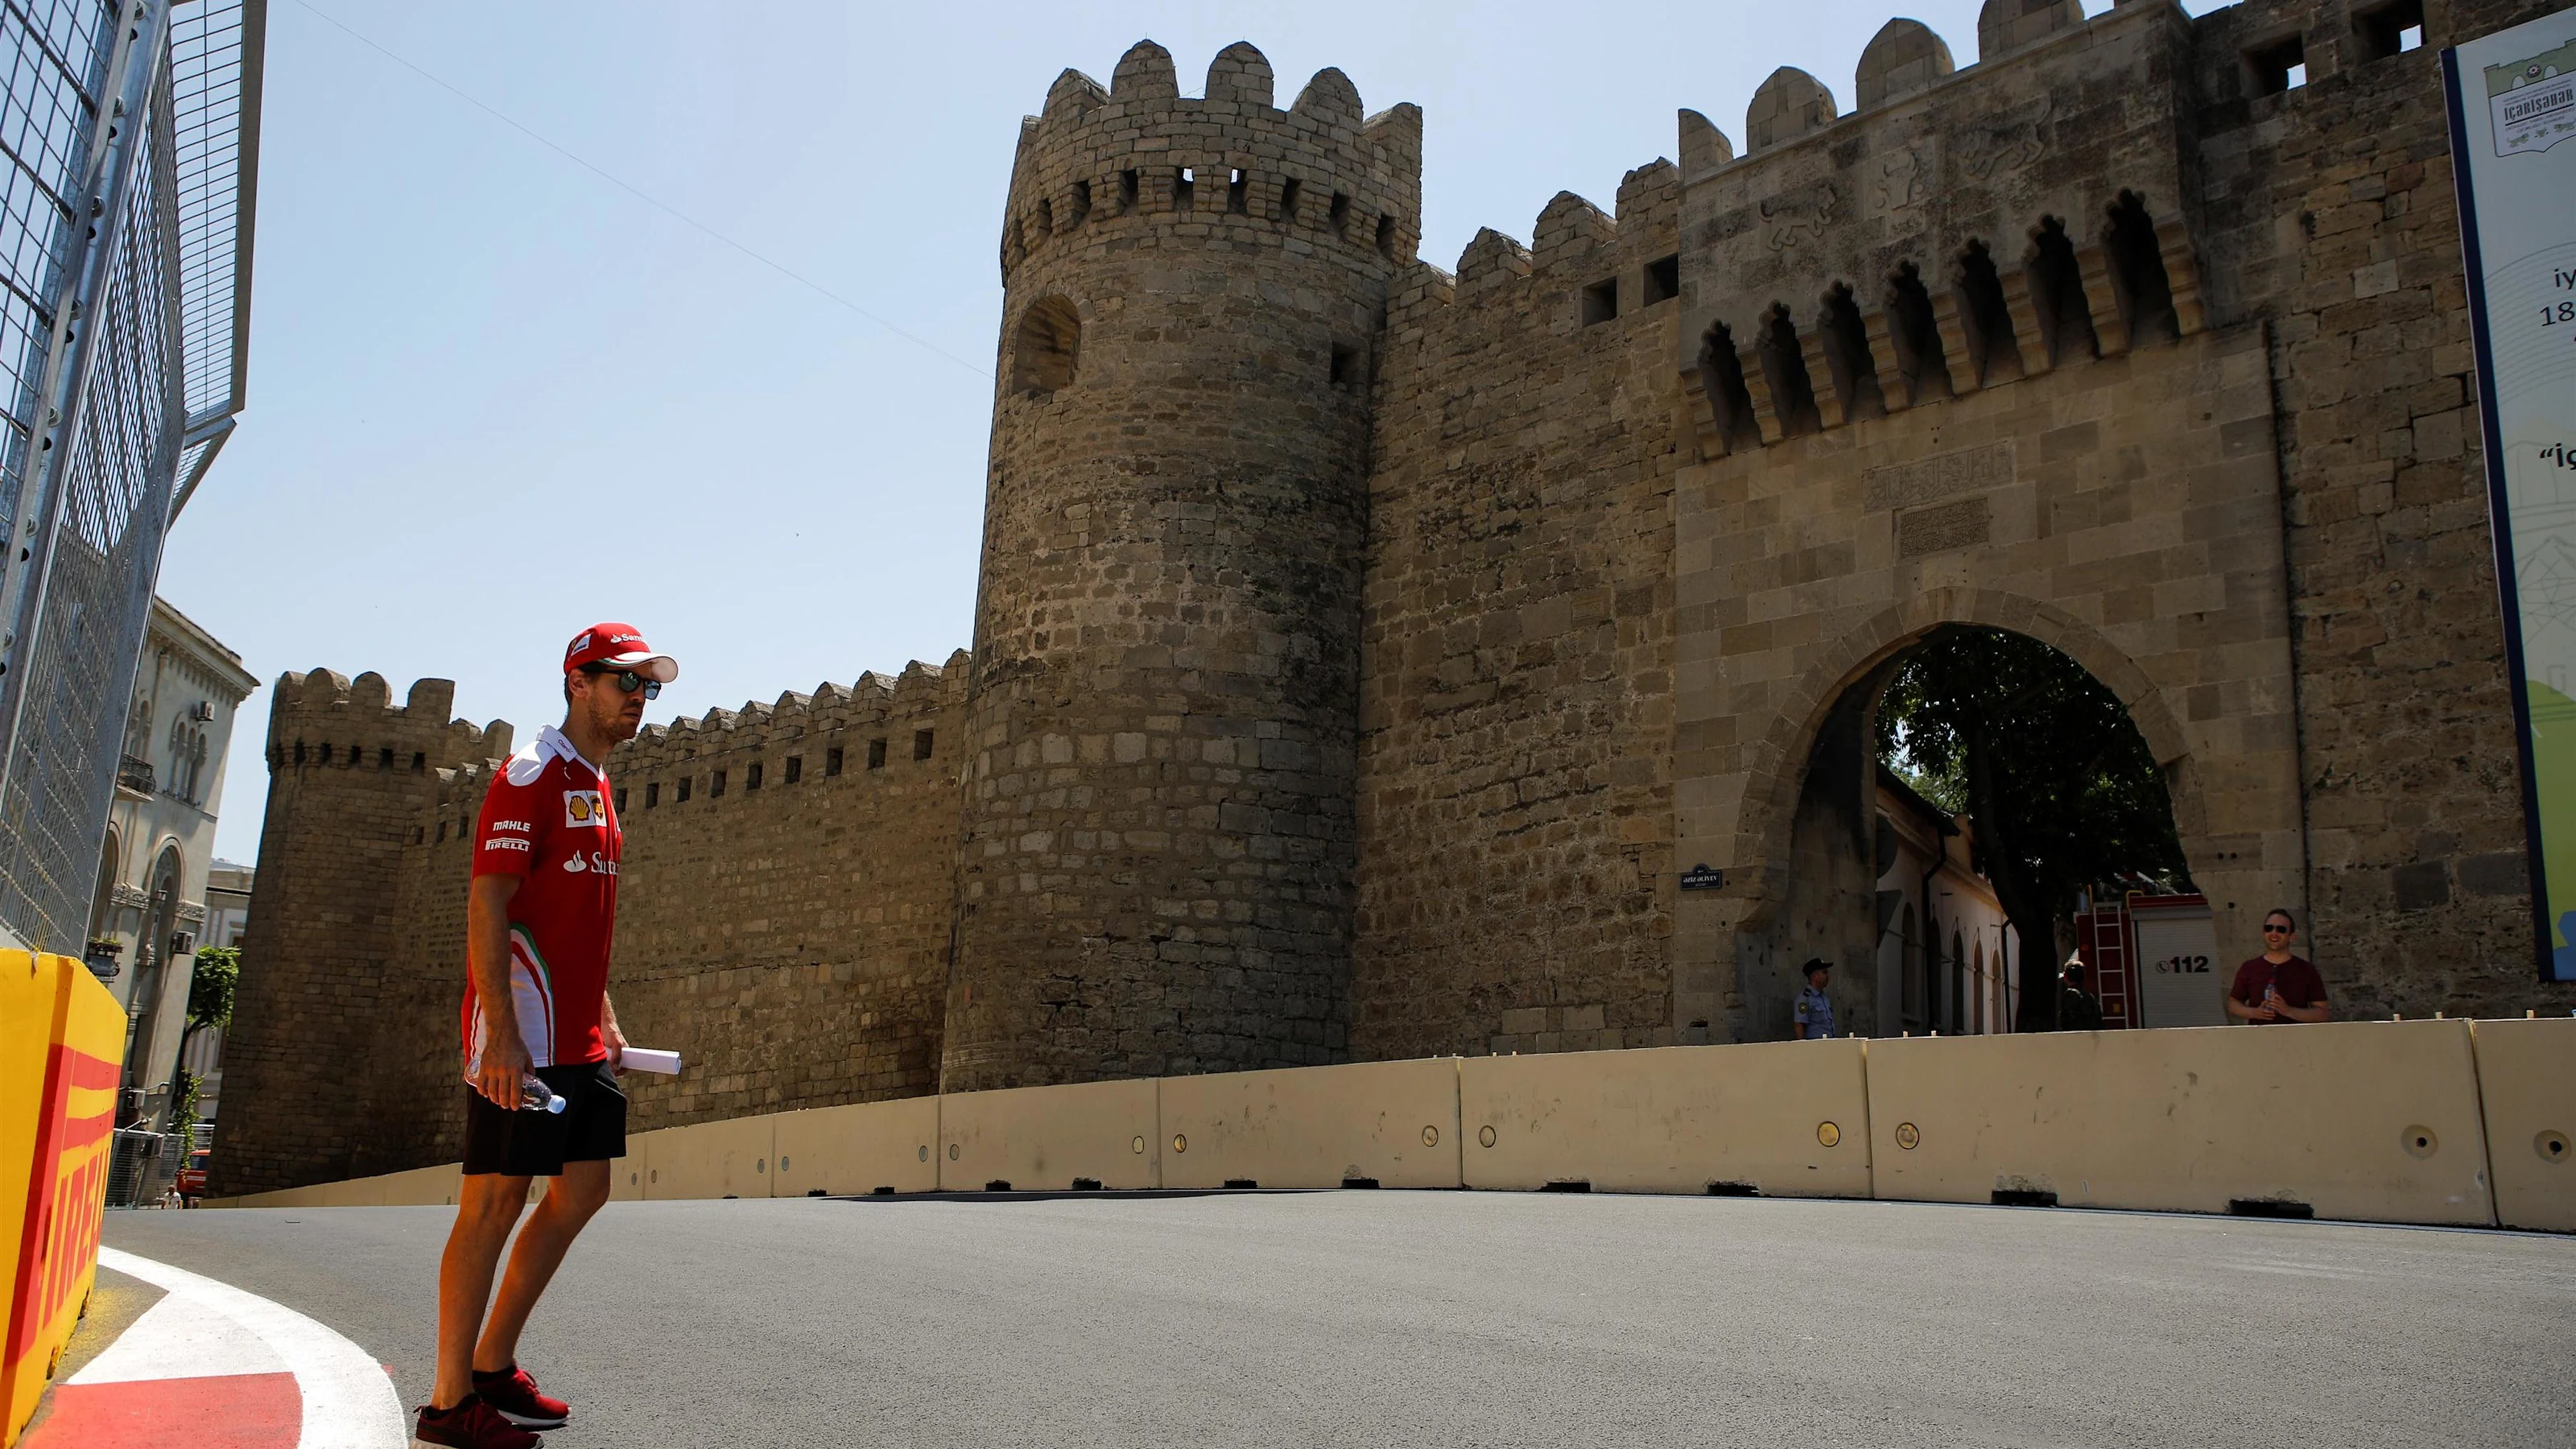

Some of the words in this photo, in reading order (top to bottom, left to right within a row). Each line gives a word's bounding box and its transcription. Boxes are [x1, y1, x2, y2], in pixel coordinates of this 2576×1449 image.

[493, 819, 531, 832] MAHLE
[485, 837, 530, 852] PIRELLI
[2170, 956, 2209, 973] 112
